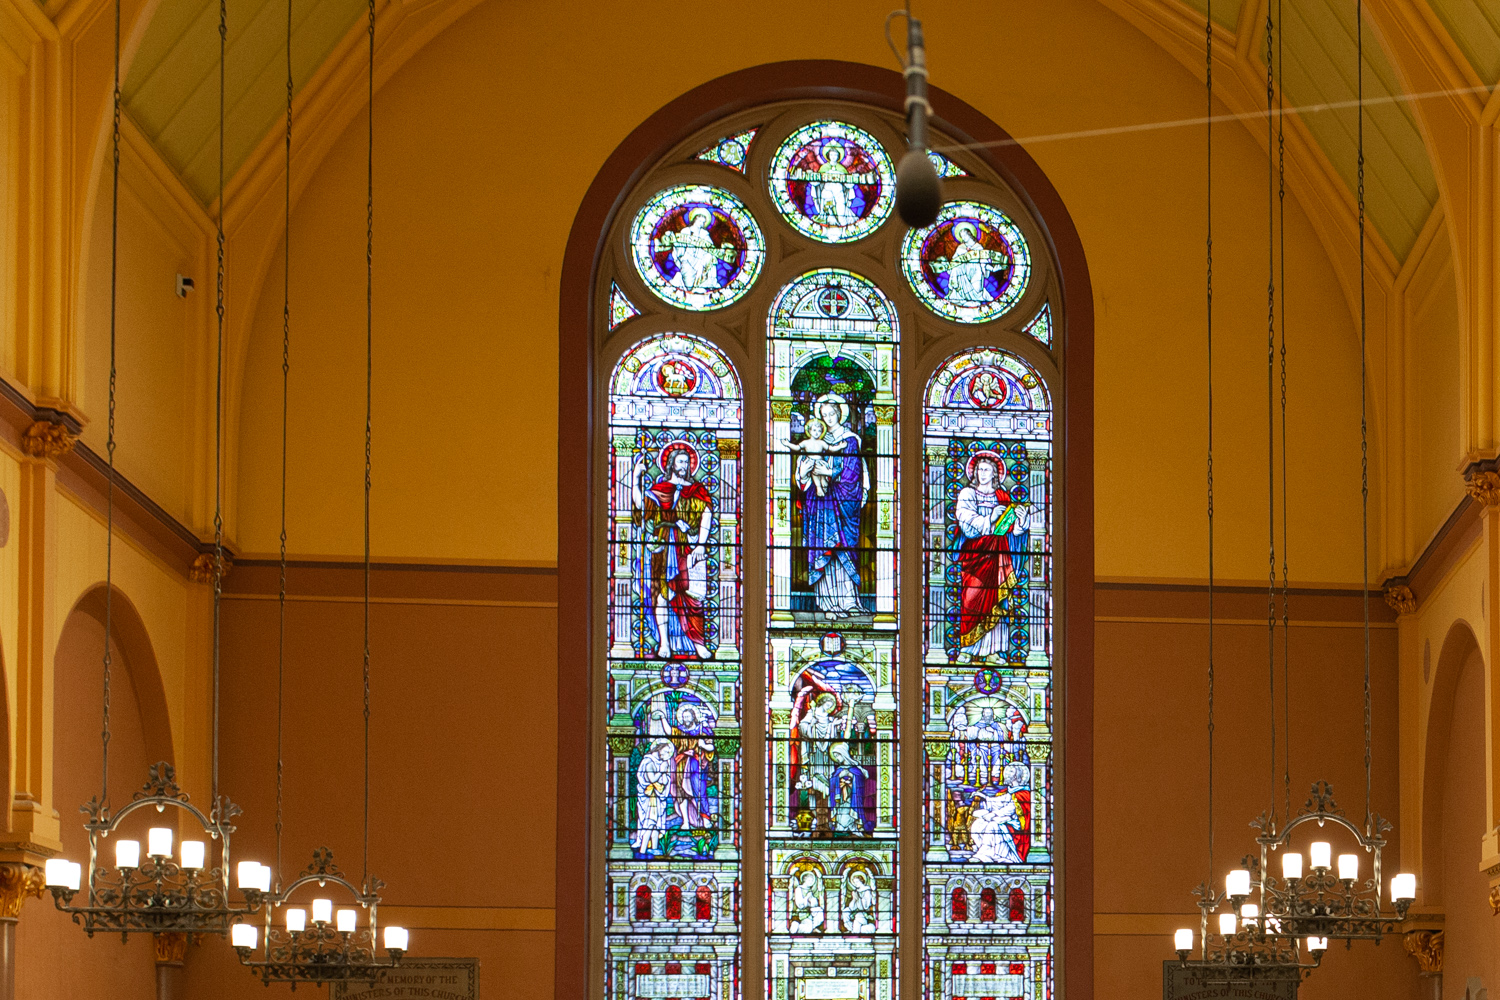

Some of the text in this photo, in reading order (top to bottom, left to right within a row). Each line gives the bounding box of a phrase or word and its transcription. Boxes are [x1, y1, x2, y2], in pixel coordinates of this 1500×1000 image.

[387, 975, 424, 984] MEMORY
[426, 975, 437, 984] OF
[439, 975, 458, 984] THE
[1183, 977, 1194, 985] TO
[393, 987, 405, 995] OF
[408, 987, 430, 996] THIS
[1233, 989, 1253, 998] THIS
